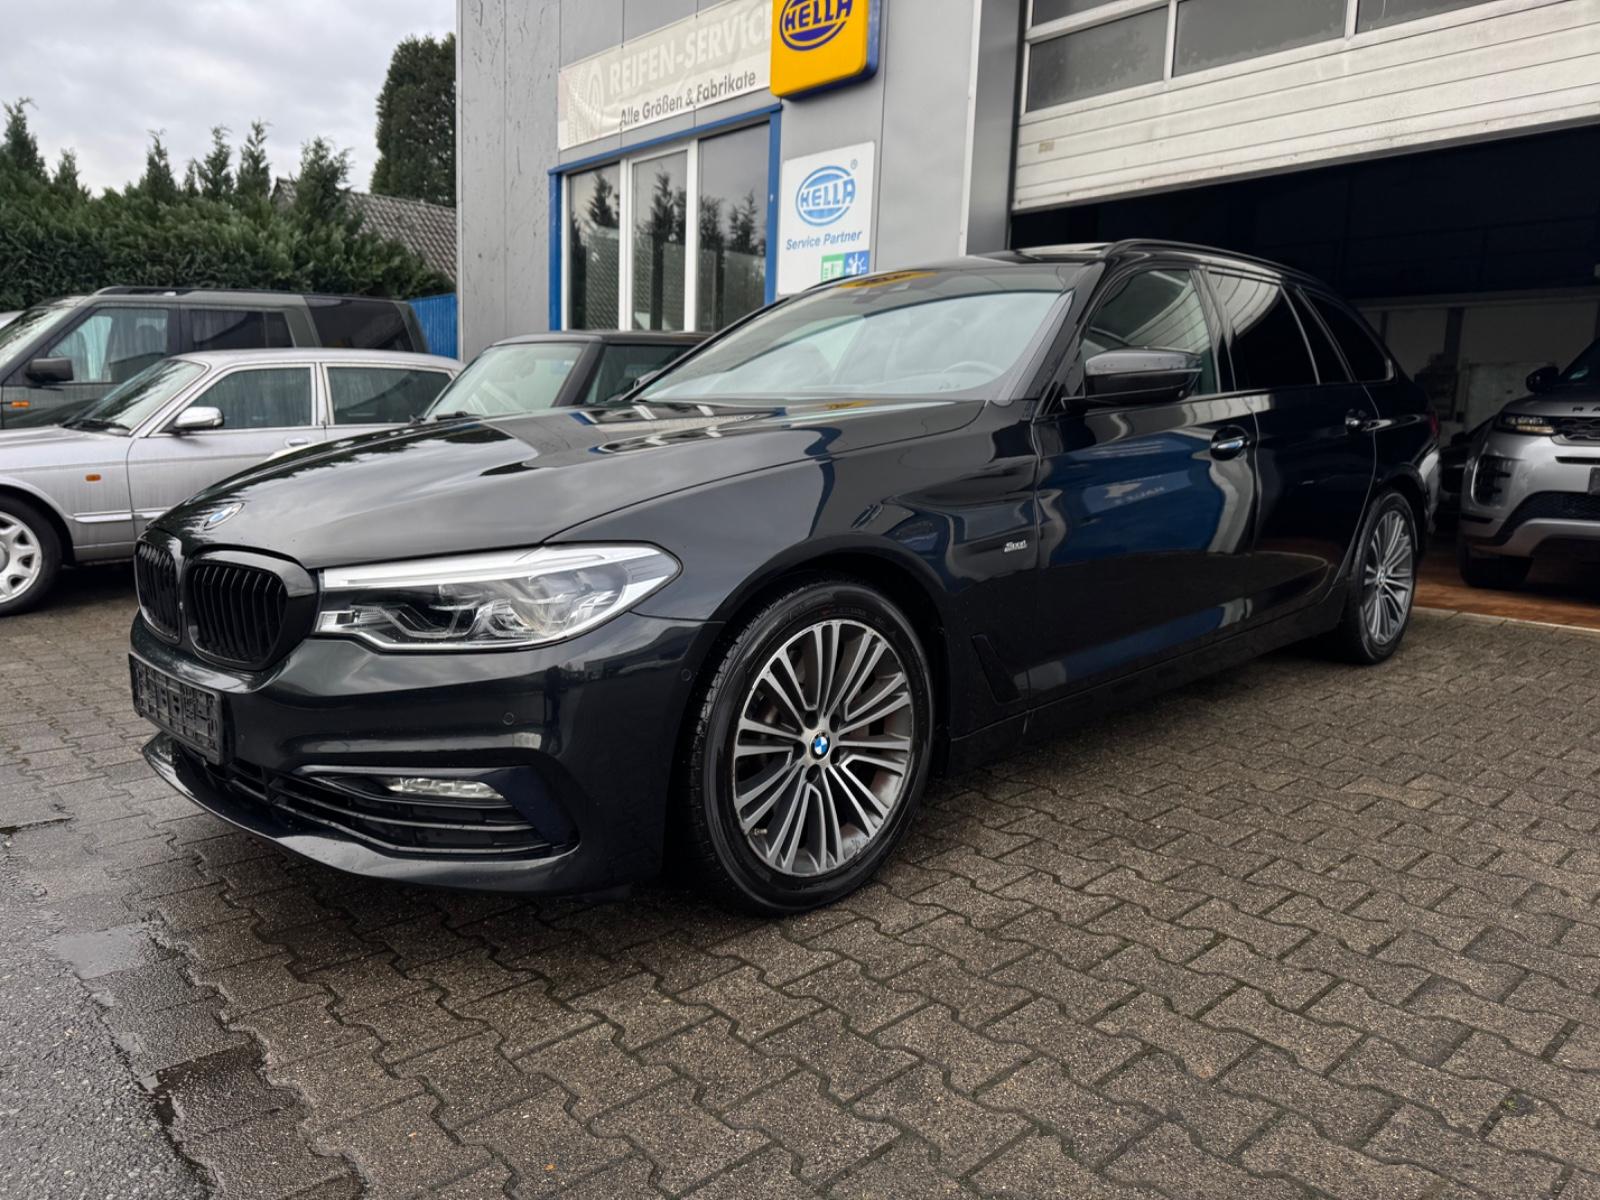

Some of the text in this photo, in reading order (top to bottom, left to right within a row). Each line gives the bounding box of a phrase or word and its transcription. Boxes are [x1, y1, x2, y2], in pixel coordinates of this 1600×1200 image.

[785, 0, 853, 31] HELLA
[619, 71, 756, 126] Alle Größen & Fabrikate
[801, 178, 855, 208] HELLA
[786, 231, 862, 250] Service Partner
